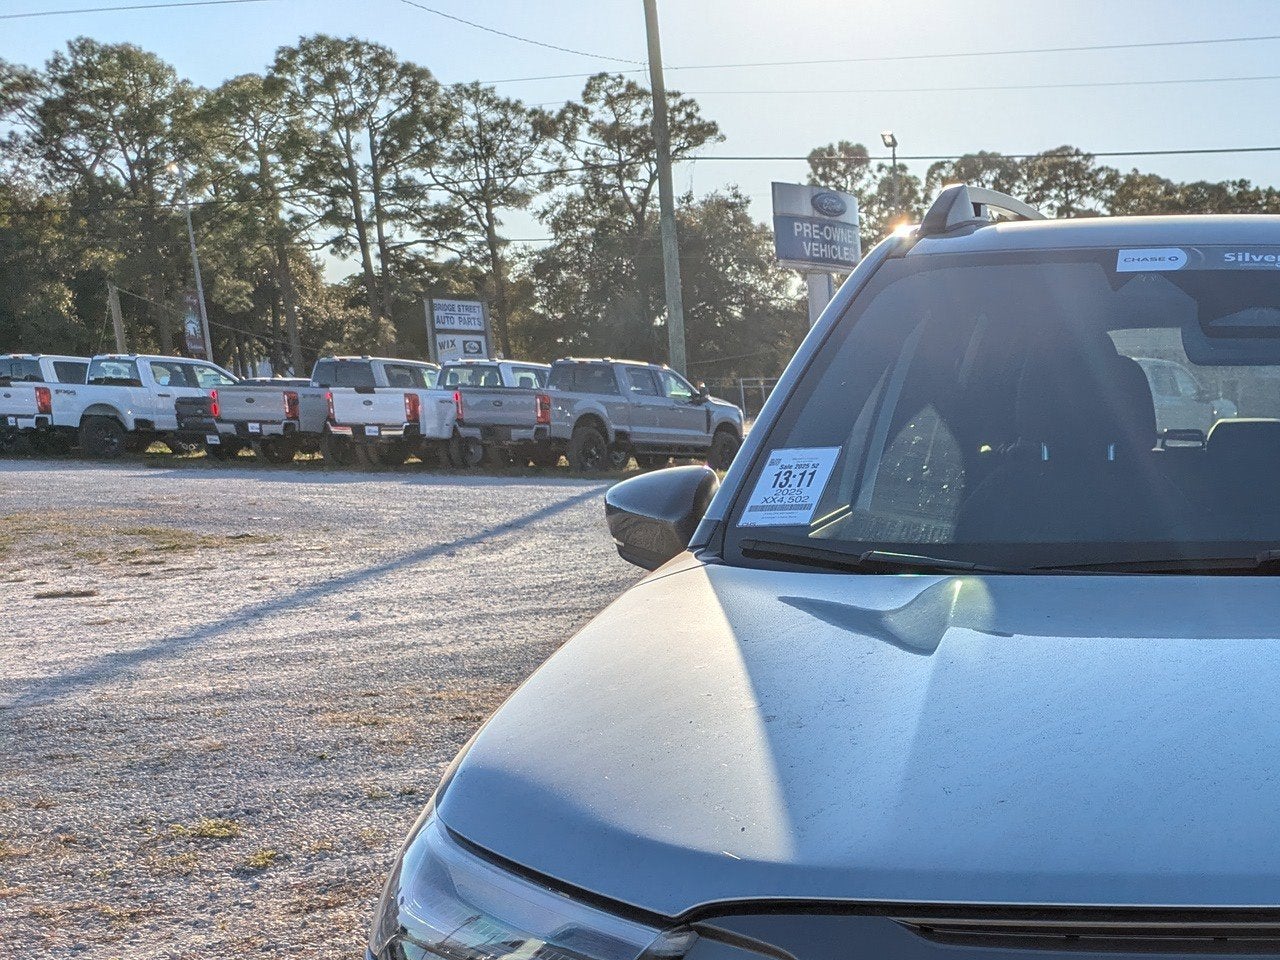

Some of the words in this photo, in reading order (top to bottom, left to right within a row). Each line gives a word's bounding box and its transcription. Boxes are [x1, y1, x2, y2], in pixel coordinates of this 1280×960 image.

[794, 222, 859, 244] PRE-OWNED
[803, 242, 855, 261] VEHICLES
[434, 303, 456, 312] BRIDGE
[457, 304, 481, 314] STREET
[436, 316, 455, 325] AUTO
[458, 317, 482, 326] PARTS
[438, 340, 456, 350] WIX
[771, 469, 817, 488] 13:11
[774, 488, 803, 496] 2025
